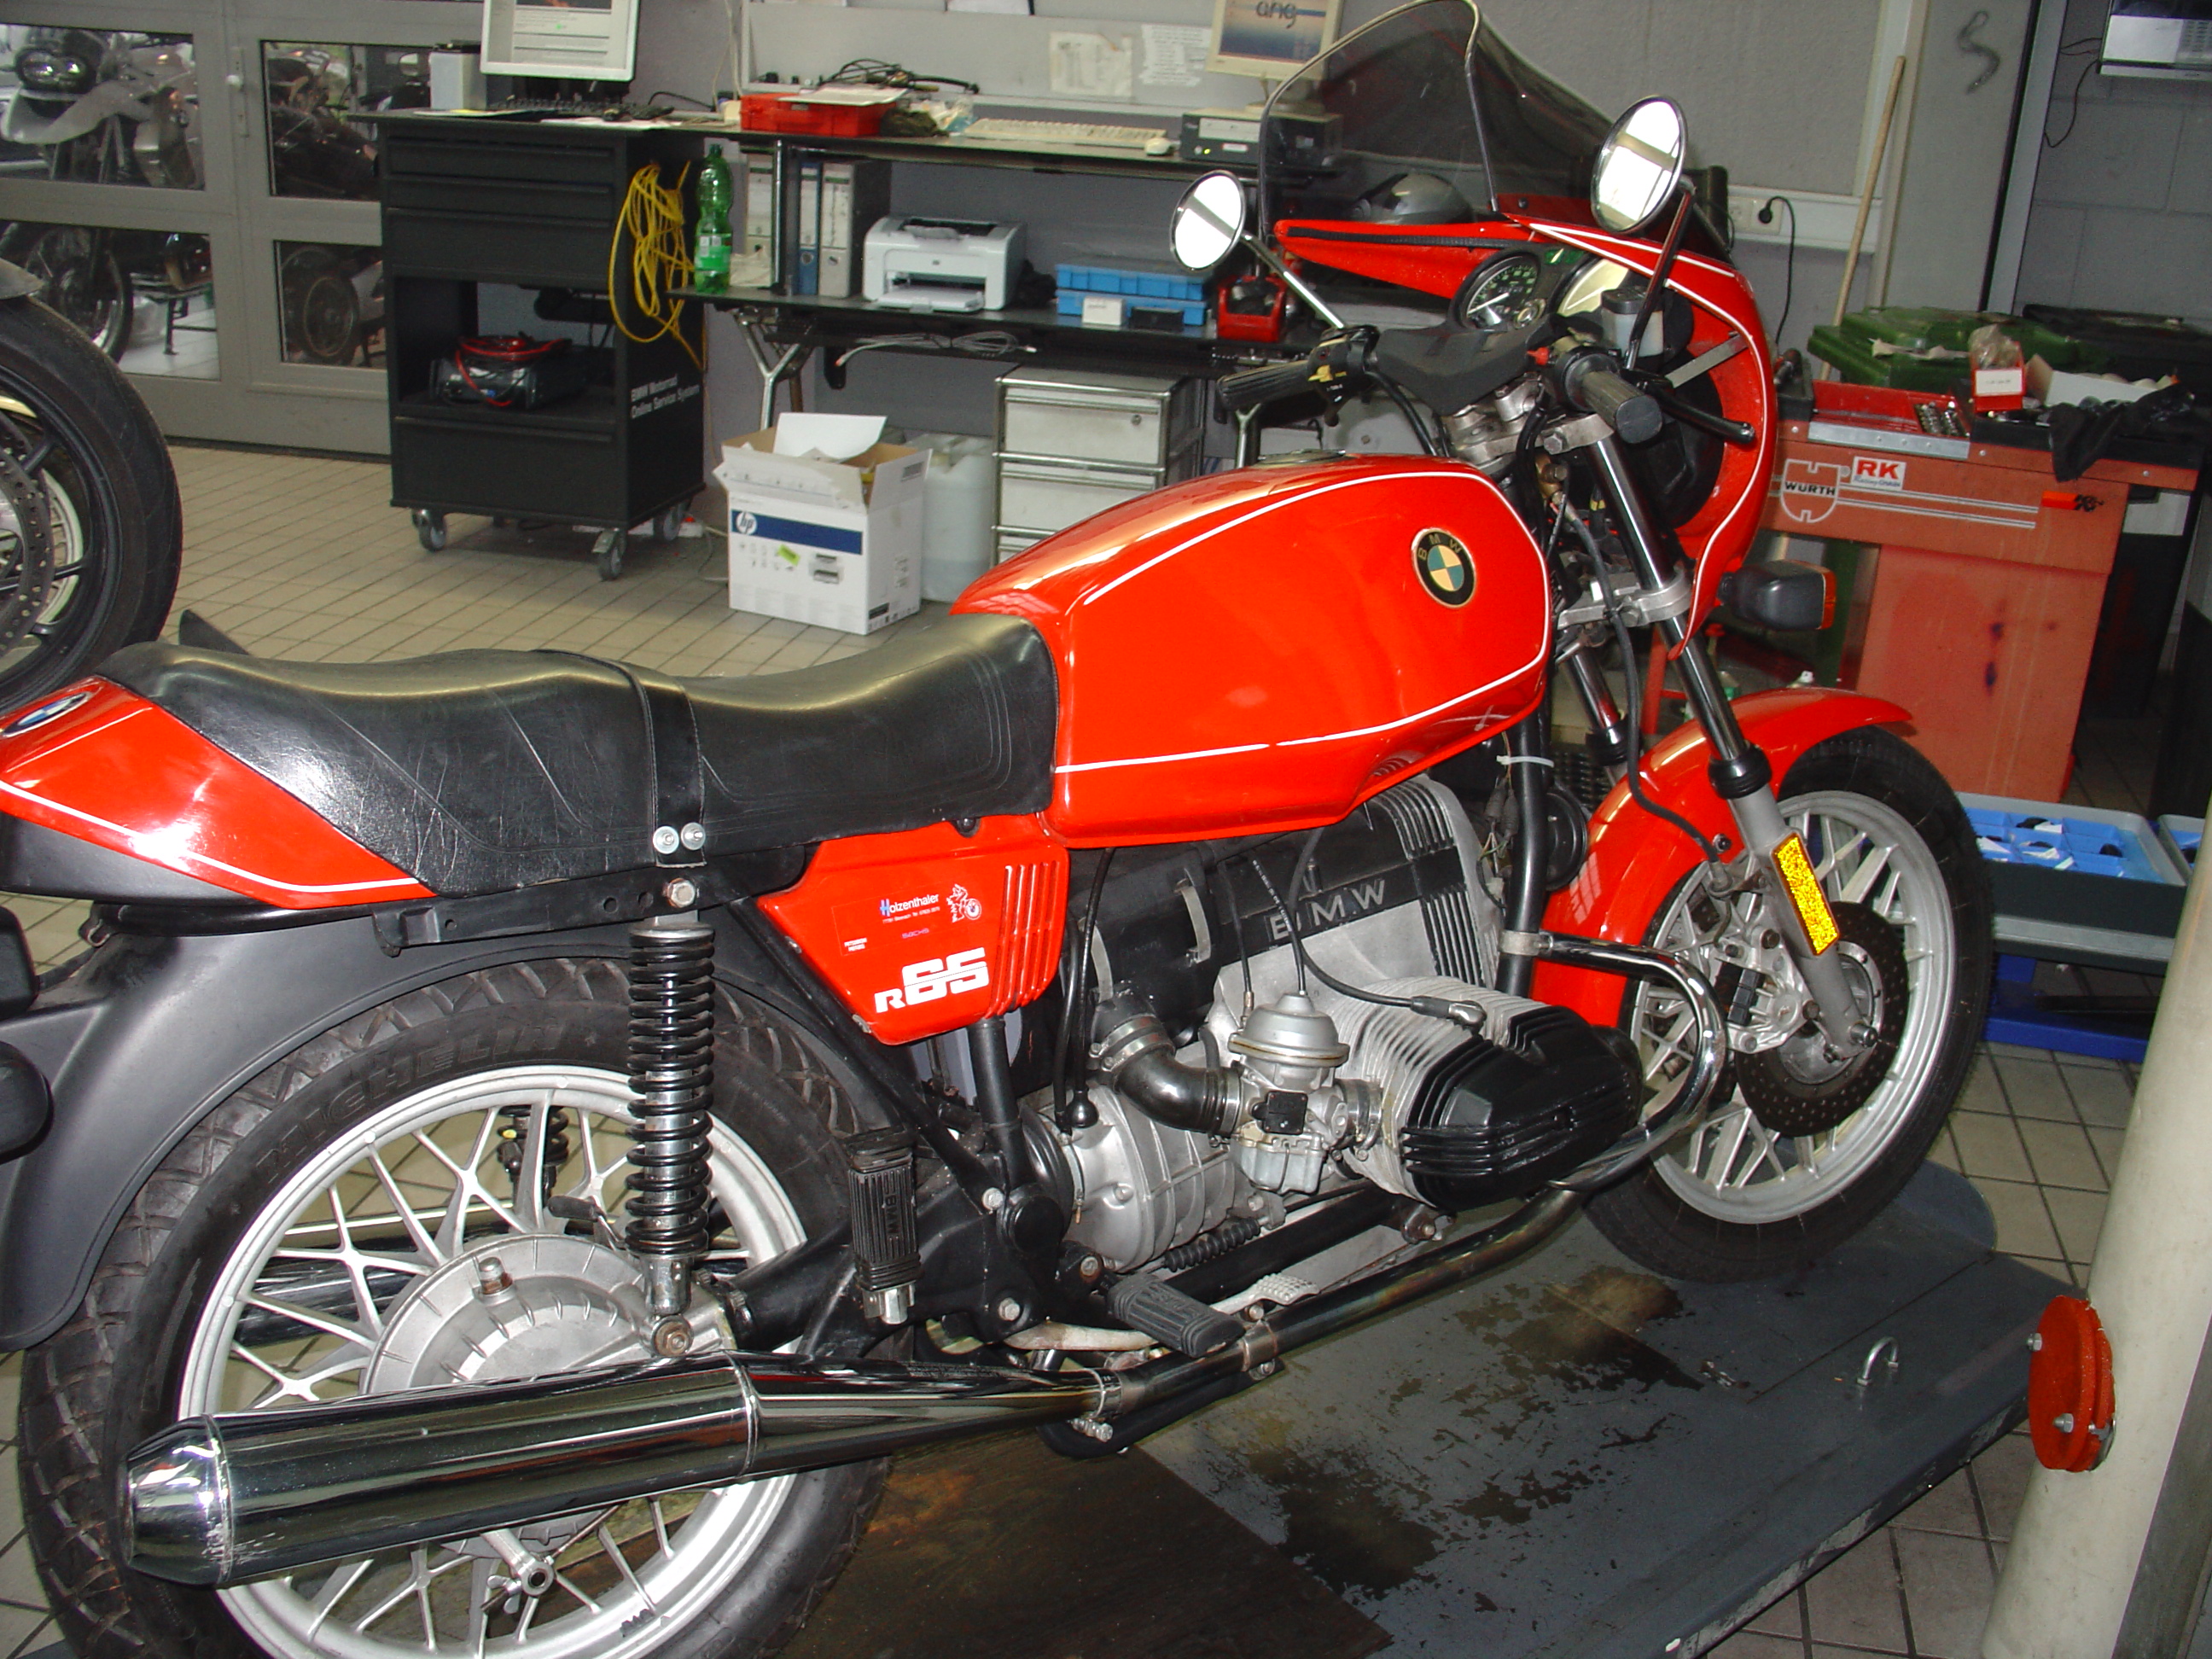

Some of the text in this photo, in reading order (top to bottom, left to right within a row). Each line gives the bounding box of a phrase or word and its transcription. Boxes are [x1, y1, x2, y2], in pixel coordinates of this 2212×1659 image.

[1856, 459, 1900, 480] RK
[738, 510, 755, 534] hp
[1417, 533, 1462, 561] BMW
[879, 894, 939, 917] Holzenthaler
[1268, 878, 1386, 941] BMW
[253, 1020, 568, 1188] MICHELIN
